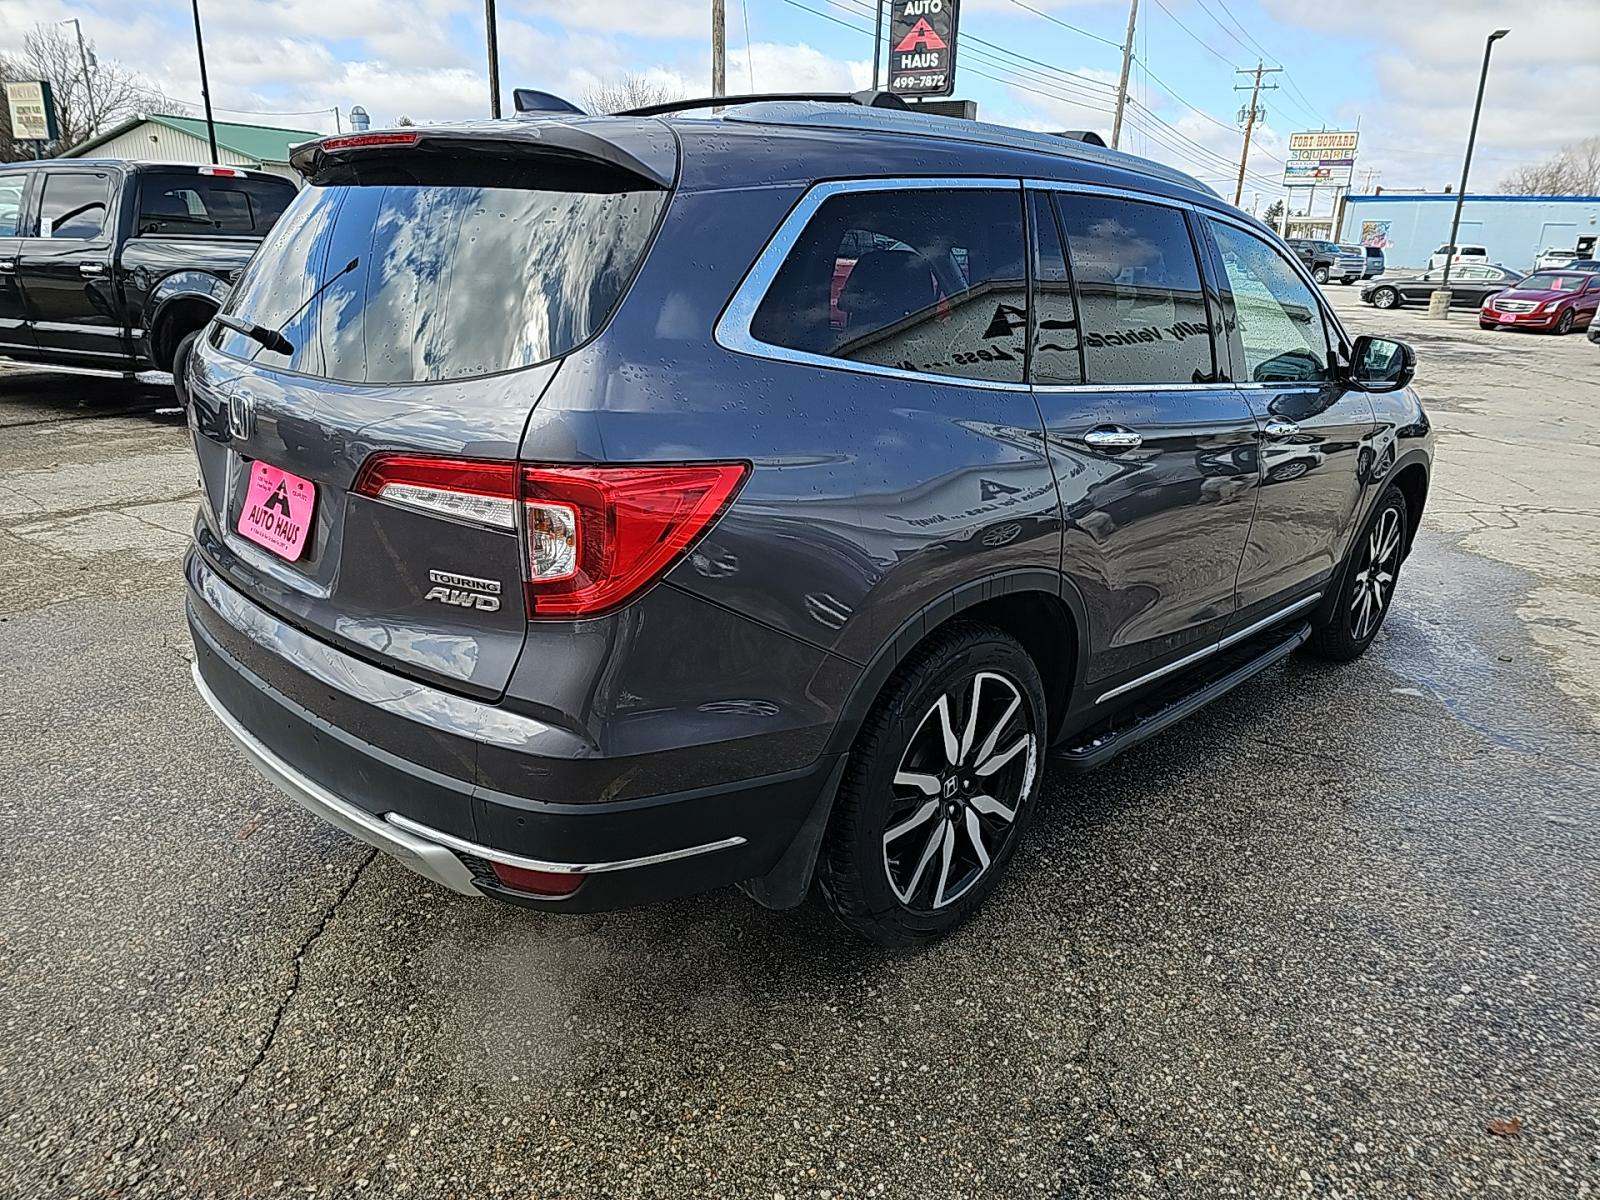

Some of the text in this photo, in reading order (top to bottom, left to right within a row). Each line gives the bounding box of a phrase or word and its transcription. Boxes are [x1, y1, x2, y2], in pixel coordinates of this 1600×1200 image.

[904, 0, 942, 16] AUTO
[901, 53, 939, 68] HAUS
[893, 75, 945, 88] 499-7872
[1292, 135, 1356, 147] FORT HOWARD
[1291, 150, 1351, 160] SQUARE
[248, 505, 275, 531] AUTO
[274, 517, 300, 545] HAUS
[430, 572, 499, 592] TOURING
[424, 586, 500, 612] AWD
